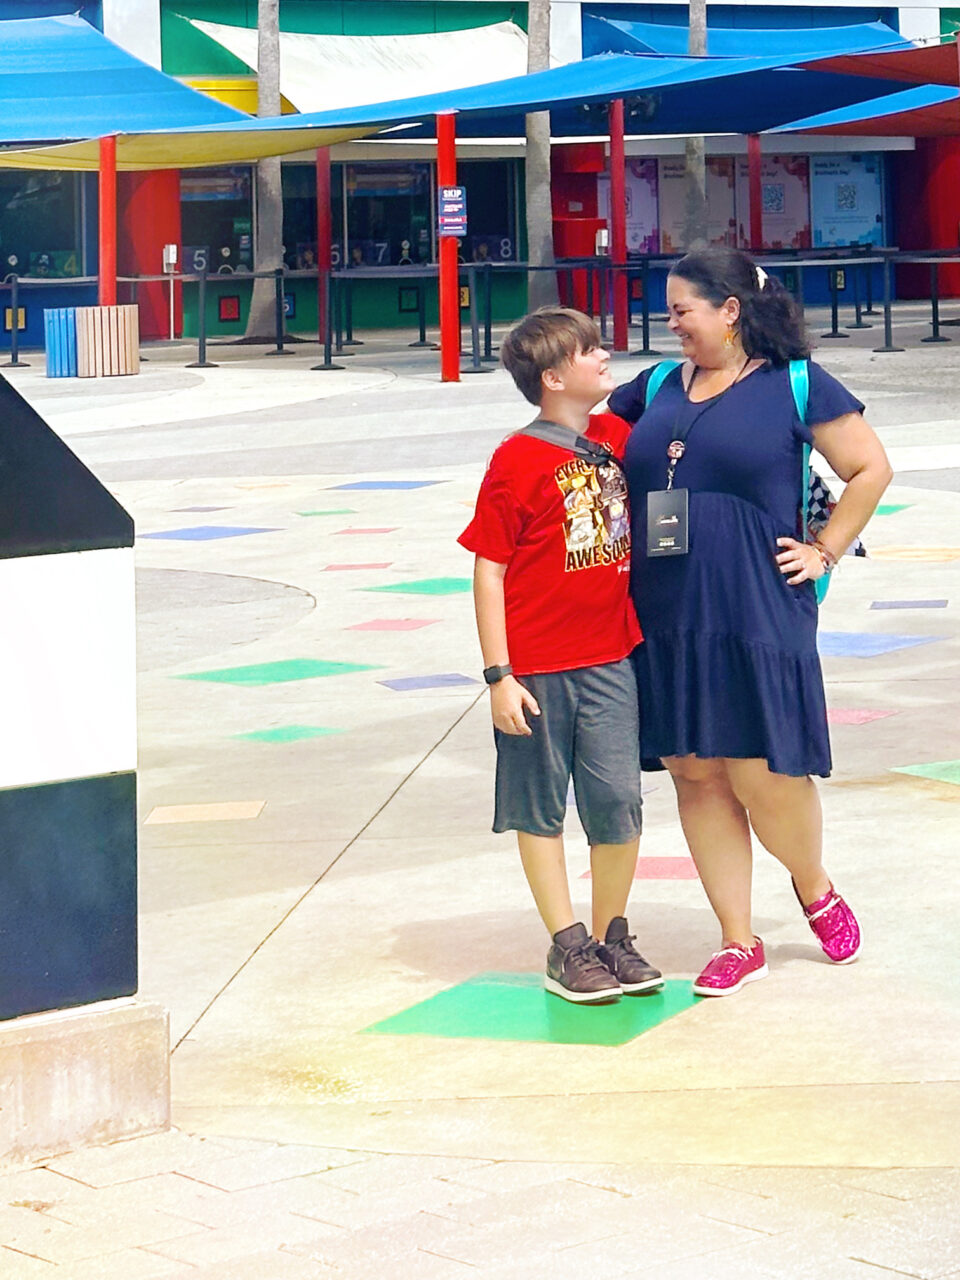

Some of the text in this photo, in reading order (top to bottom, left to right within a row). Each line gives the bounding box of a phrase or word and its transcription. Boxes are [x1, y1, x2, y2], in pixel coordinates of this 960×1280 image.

[443, 189, 462, 198] SKIP
[330, 244, 340, 265] 6
[375, 242, 388, 263] 7
[500, 238, 512, 258] 8
[64, 255, 76, 275] 4
[193, 249, 206, 271] 5
[593, 492, 604, 510] IS
[565, 533, 632, 572] AWESOM
